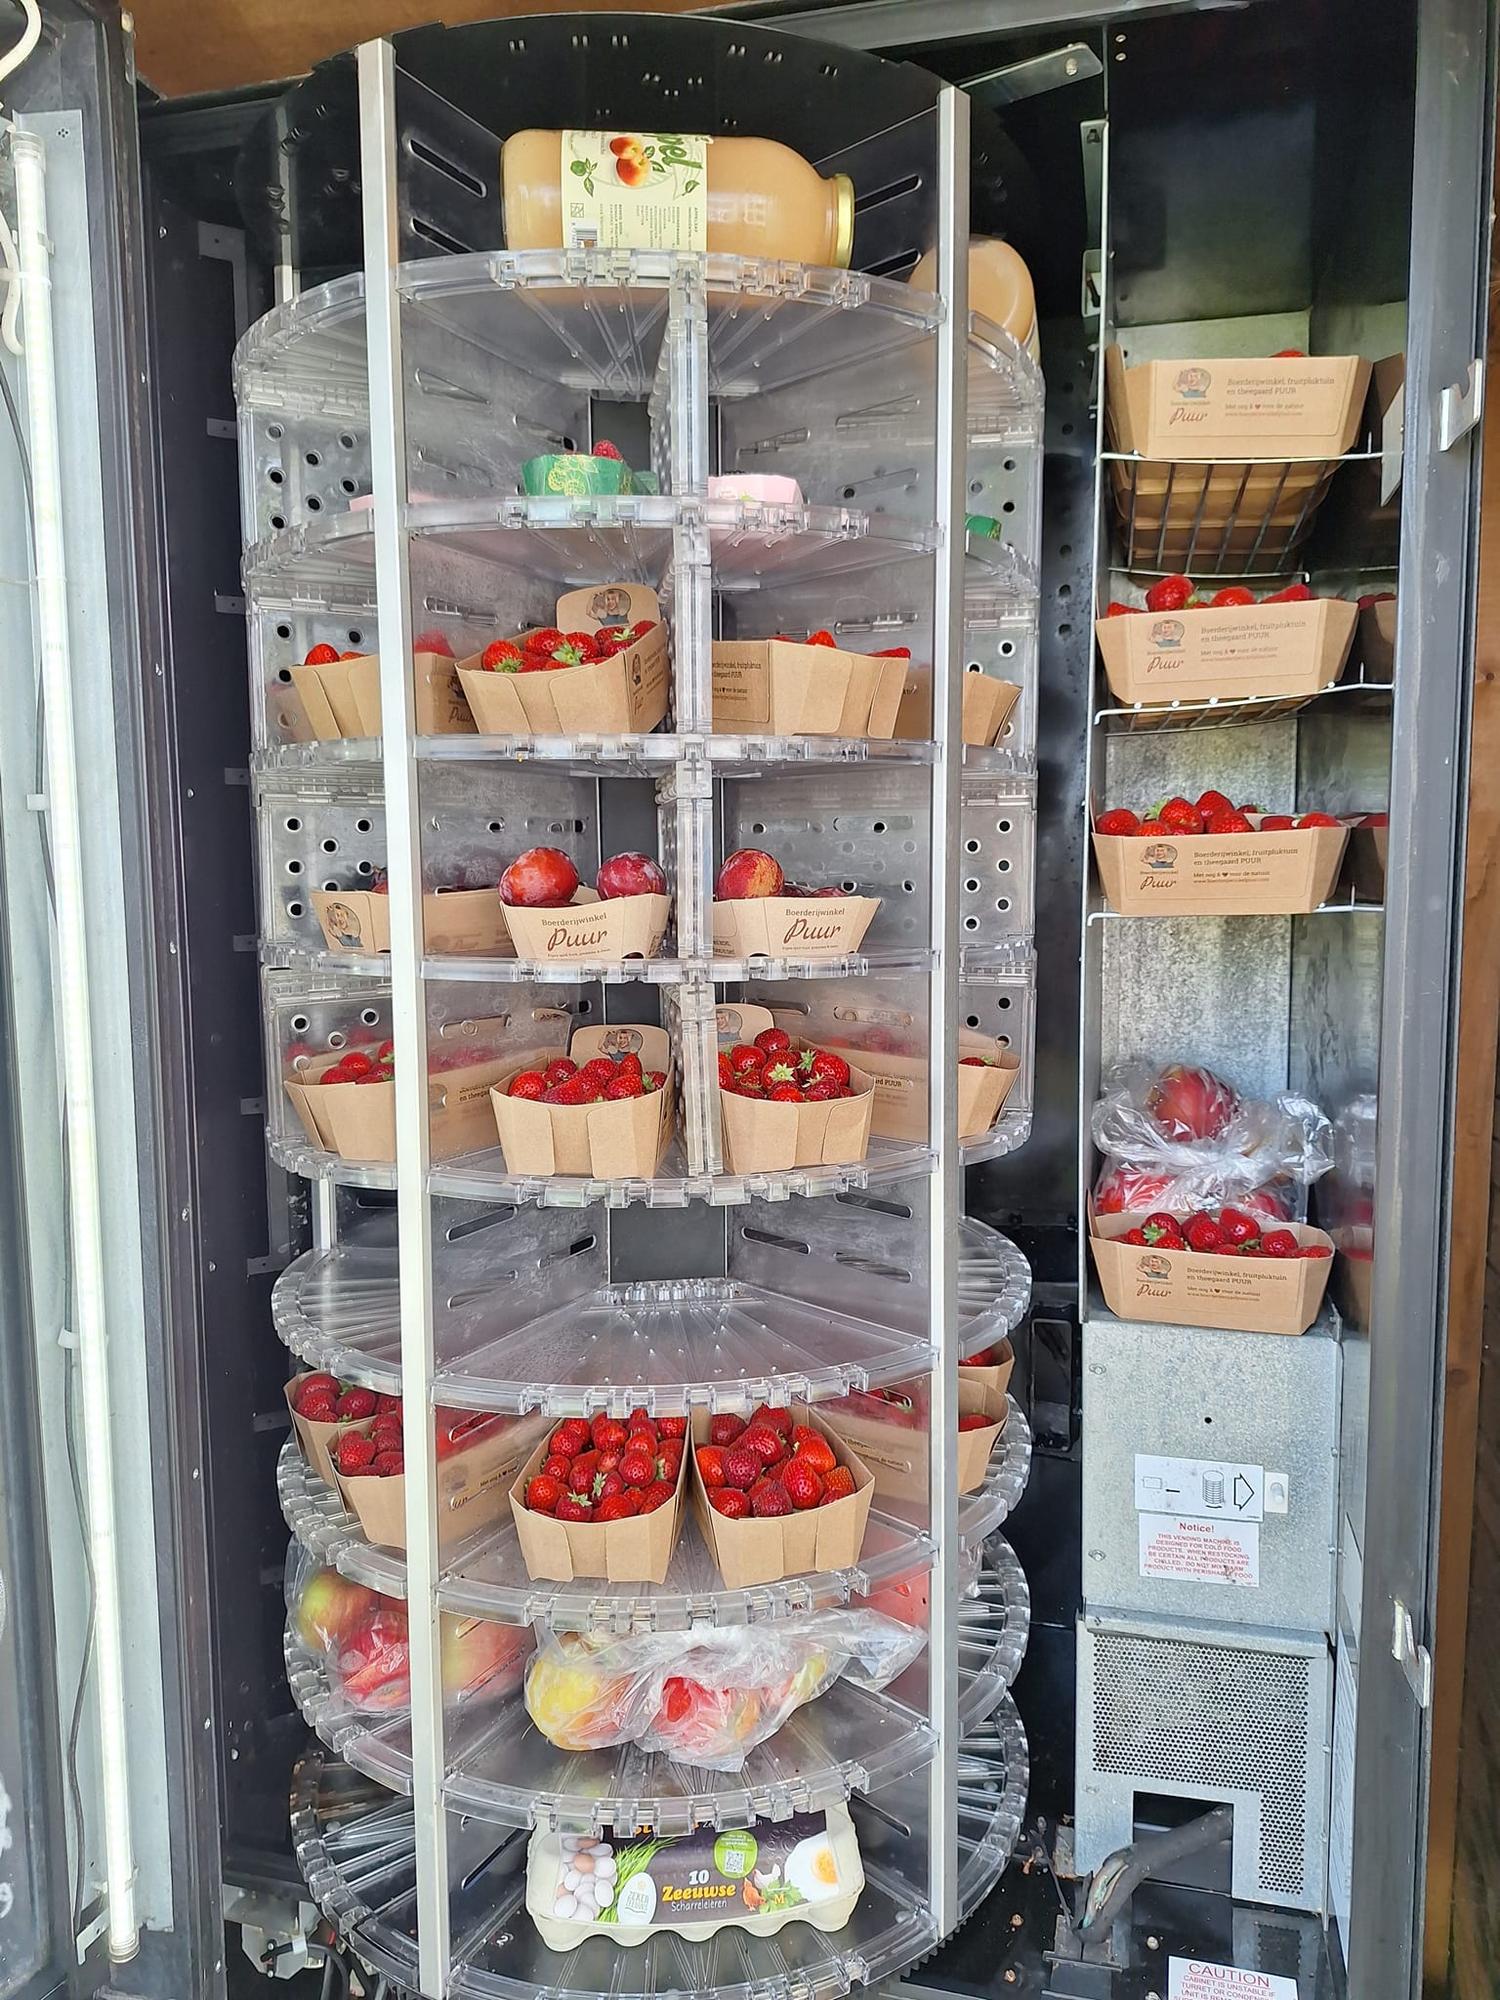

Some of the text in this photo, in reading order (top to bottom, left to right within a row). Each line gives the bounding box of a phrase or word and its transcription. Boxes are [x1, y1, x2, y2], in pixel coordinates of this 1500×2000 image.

[1169, 407, 1208, 425] Puur
[1147, 656, 1184, 673] Puur
[1140, 876, 1177, 890] Puur
[541, 912, 607, 926] Boerderijwinkel
[785, 908, 845, 918] Boerderijwinkel
[783, 918, 841, 944] Puur
[547, 927, 608, 952] Puur
[1137, 1284, 1172, 1297] Puur
[1179, 1522, 1215, 1533] Notice!
[1155, 1540, 1188, 1548] DESIGNED
[1204, 1543, 1222, 1551] COLD
[1173, 1534, 1202, 1542] VENDING
[1203, 1537, 1232, 1545] MACHINE
[1158, 1552, 1186, 1560] CERTAIN
[1200, 1556, 1235, 1565] PRODUCTS
[1144, 1563, 1174, 1572] PRODUCT
[688, 1870, 710, 1886] 10
[662, 1884, 737, 1902] Zeeuwse
[774, 1893, 785, 1904] M
[671, 1899, 728, 1912] Scharreleieren
[1188, 1963, 1270, 1988] CAUTION
[1182, 1982, 1212, 1993] TURRET
[1213, 1988, 1225, 1996] OR
[1184, 1975, 1216, 1987] CABINET
[1227, 1983, 1267, 1997] UNSTABLE
[1181, 1989, 1199, 1999] UNIT
